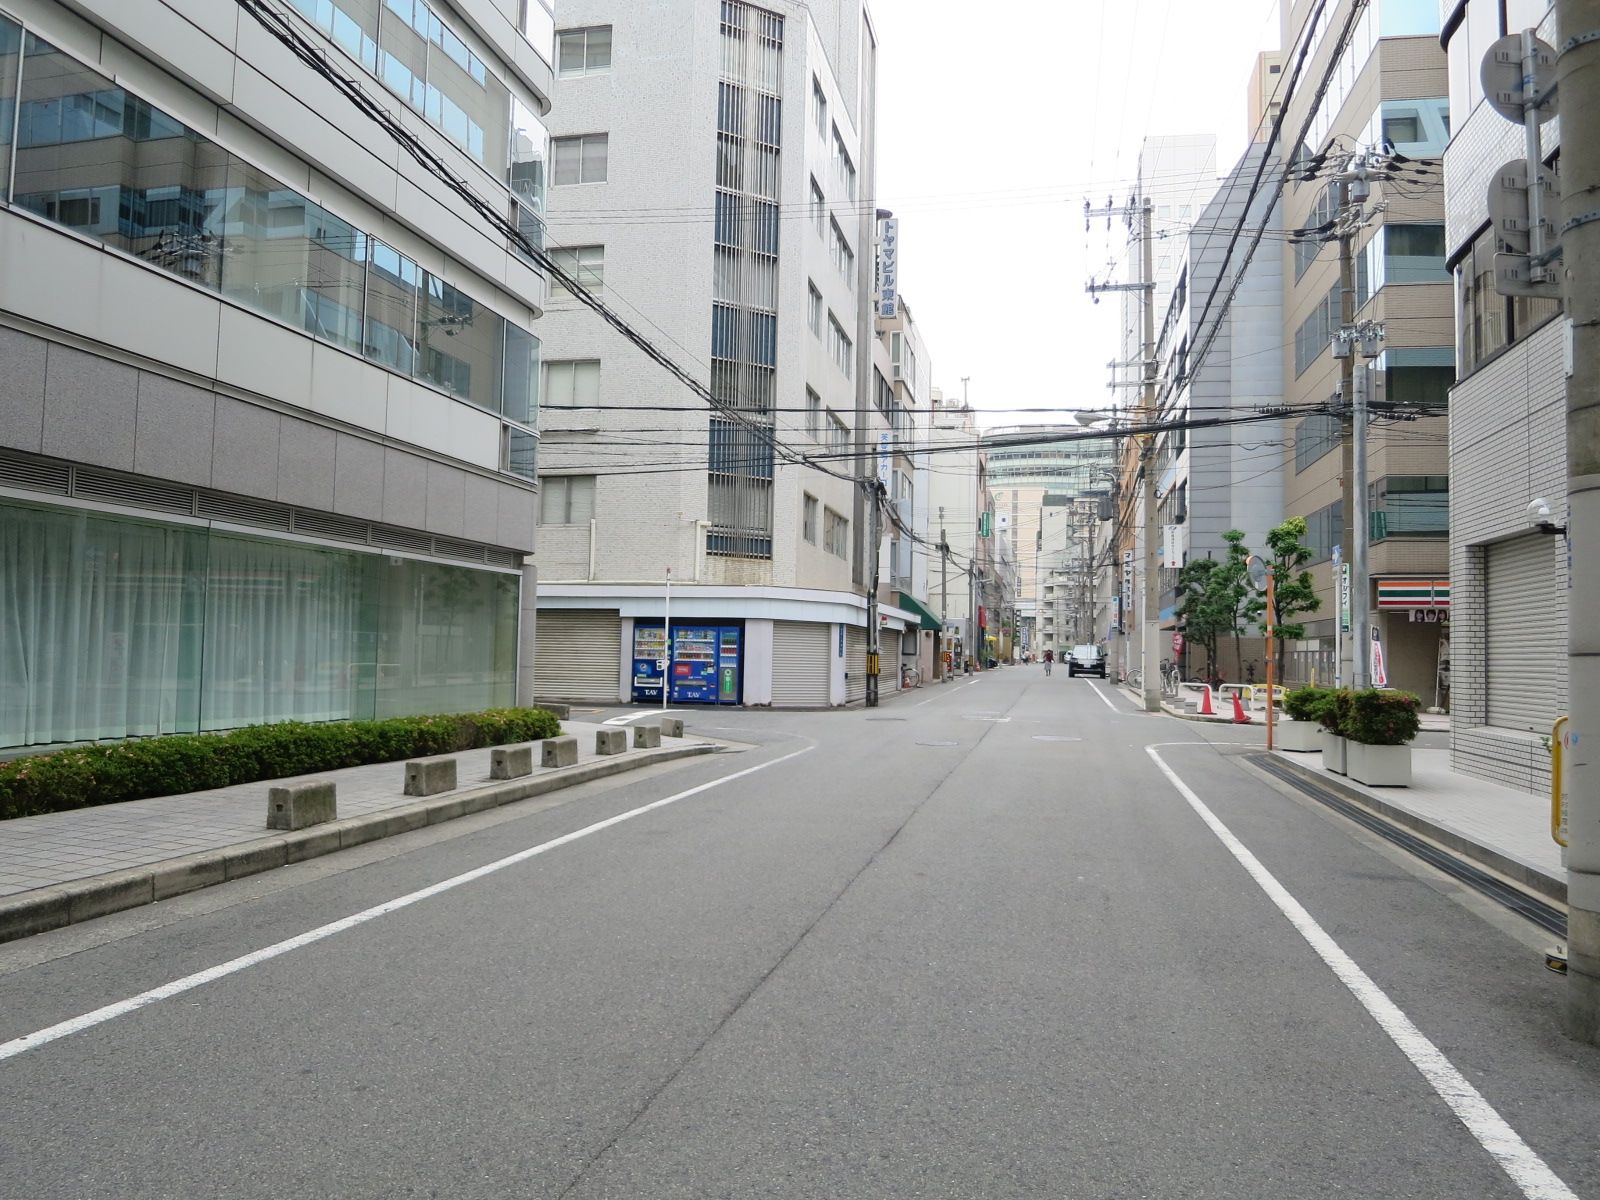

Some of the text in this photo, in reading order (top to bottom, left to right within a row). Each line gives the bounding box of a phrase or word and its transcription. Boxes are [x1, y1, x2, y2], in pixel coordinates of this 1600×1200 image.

[881, 220, 895, 316] トヤマビル東館
